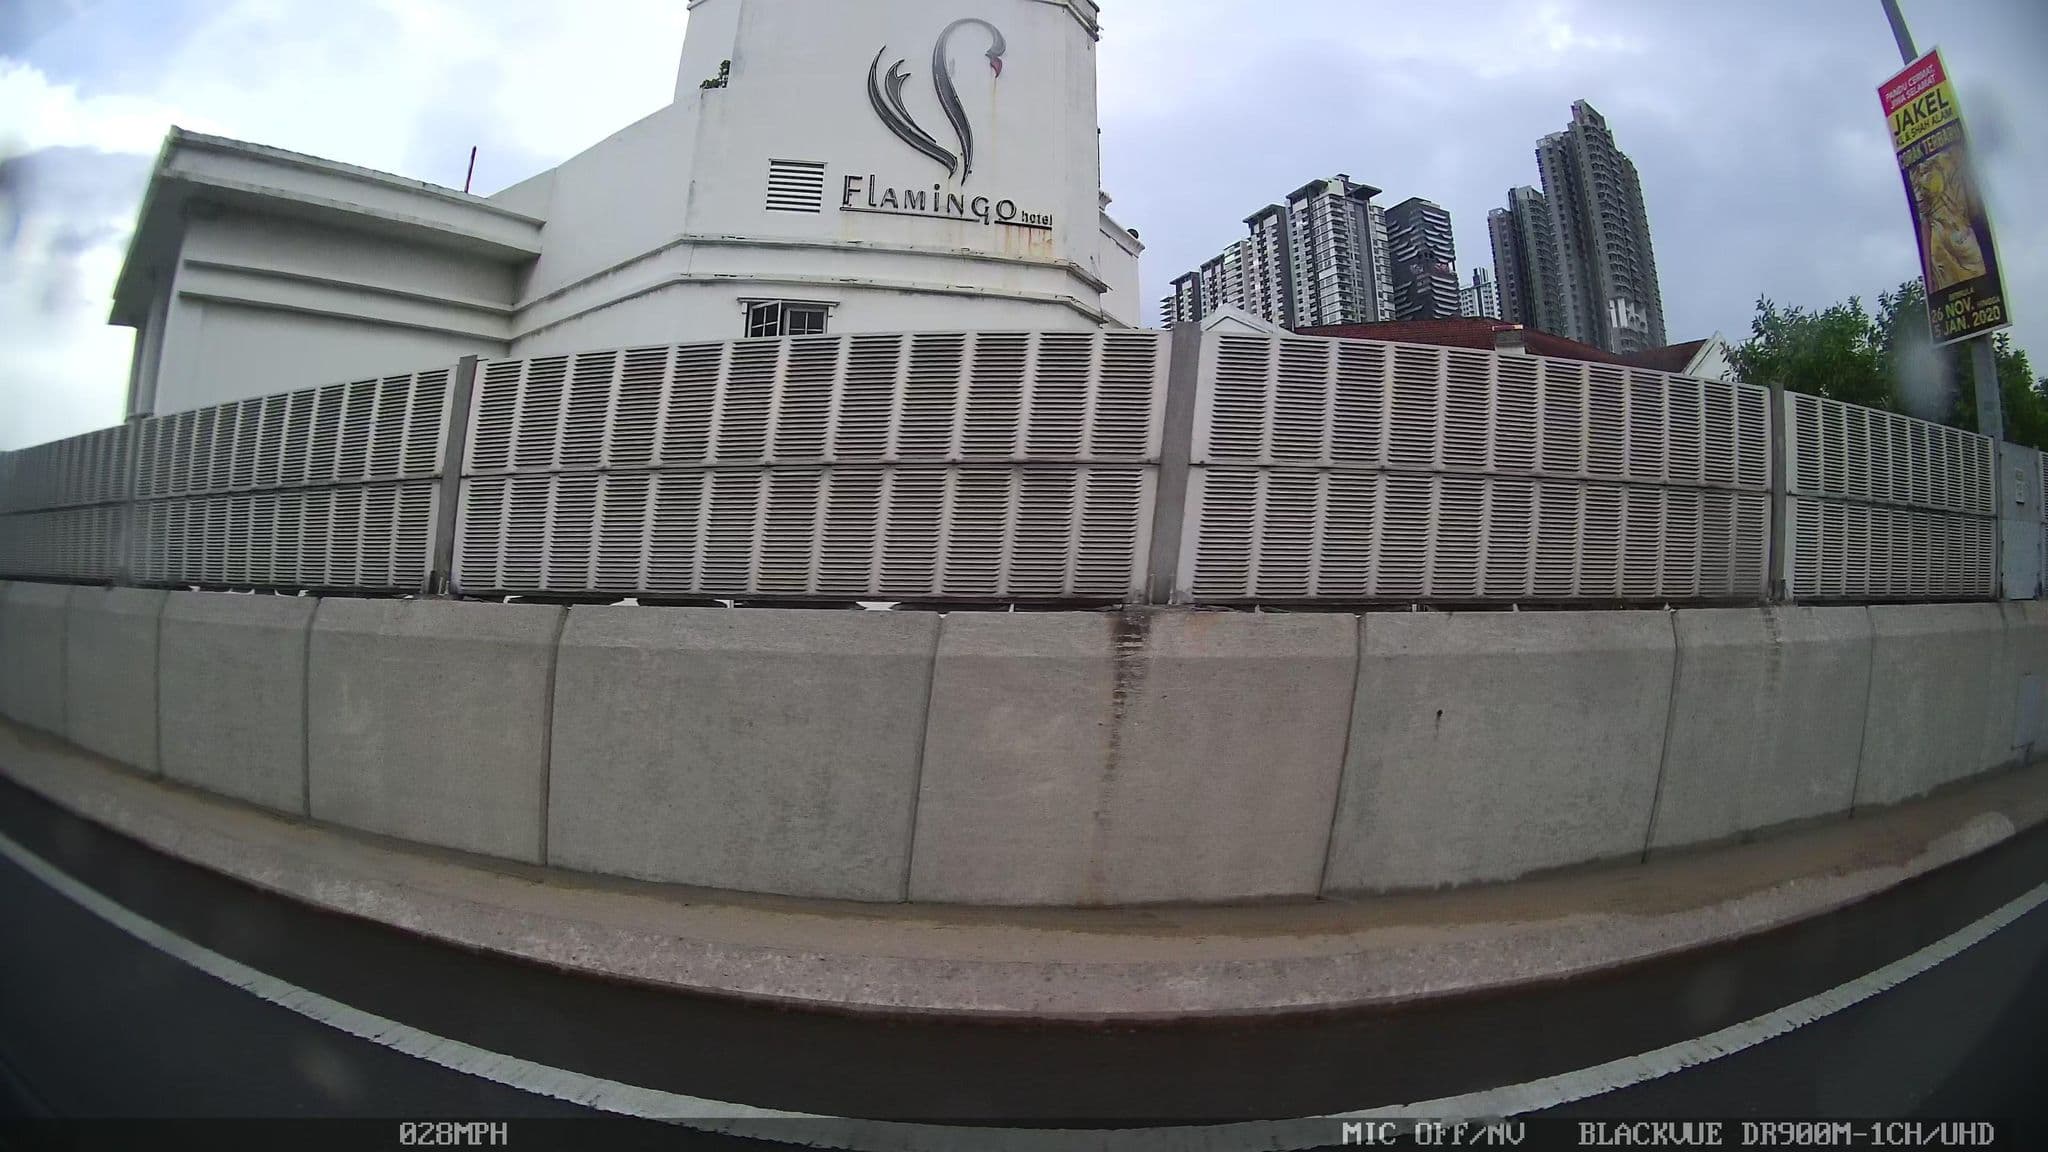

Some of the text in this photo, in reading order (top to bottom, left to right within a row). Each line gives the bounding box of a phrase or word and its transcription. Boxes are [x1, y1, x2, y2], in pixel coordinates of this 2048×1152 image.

[1893, 88, 1949, 136] JAKEL
[1021, 209, 1053, 226] hotel
[1931, 307, 1944, 324] 26
[1945, 297, 1974, 319] NOV.
[1943, 315, 1971, 336] JAN.
[1972, 305, 2001, 327] 2020
